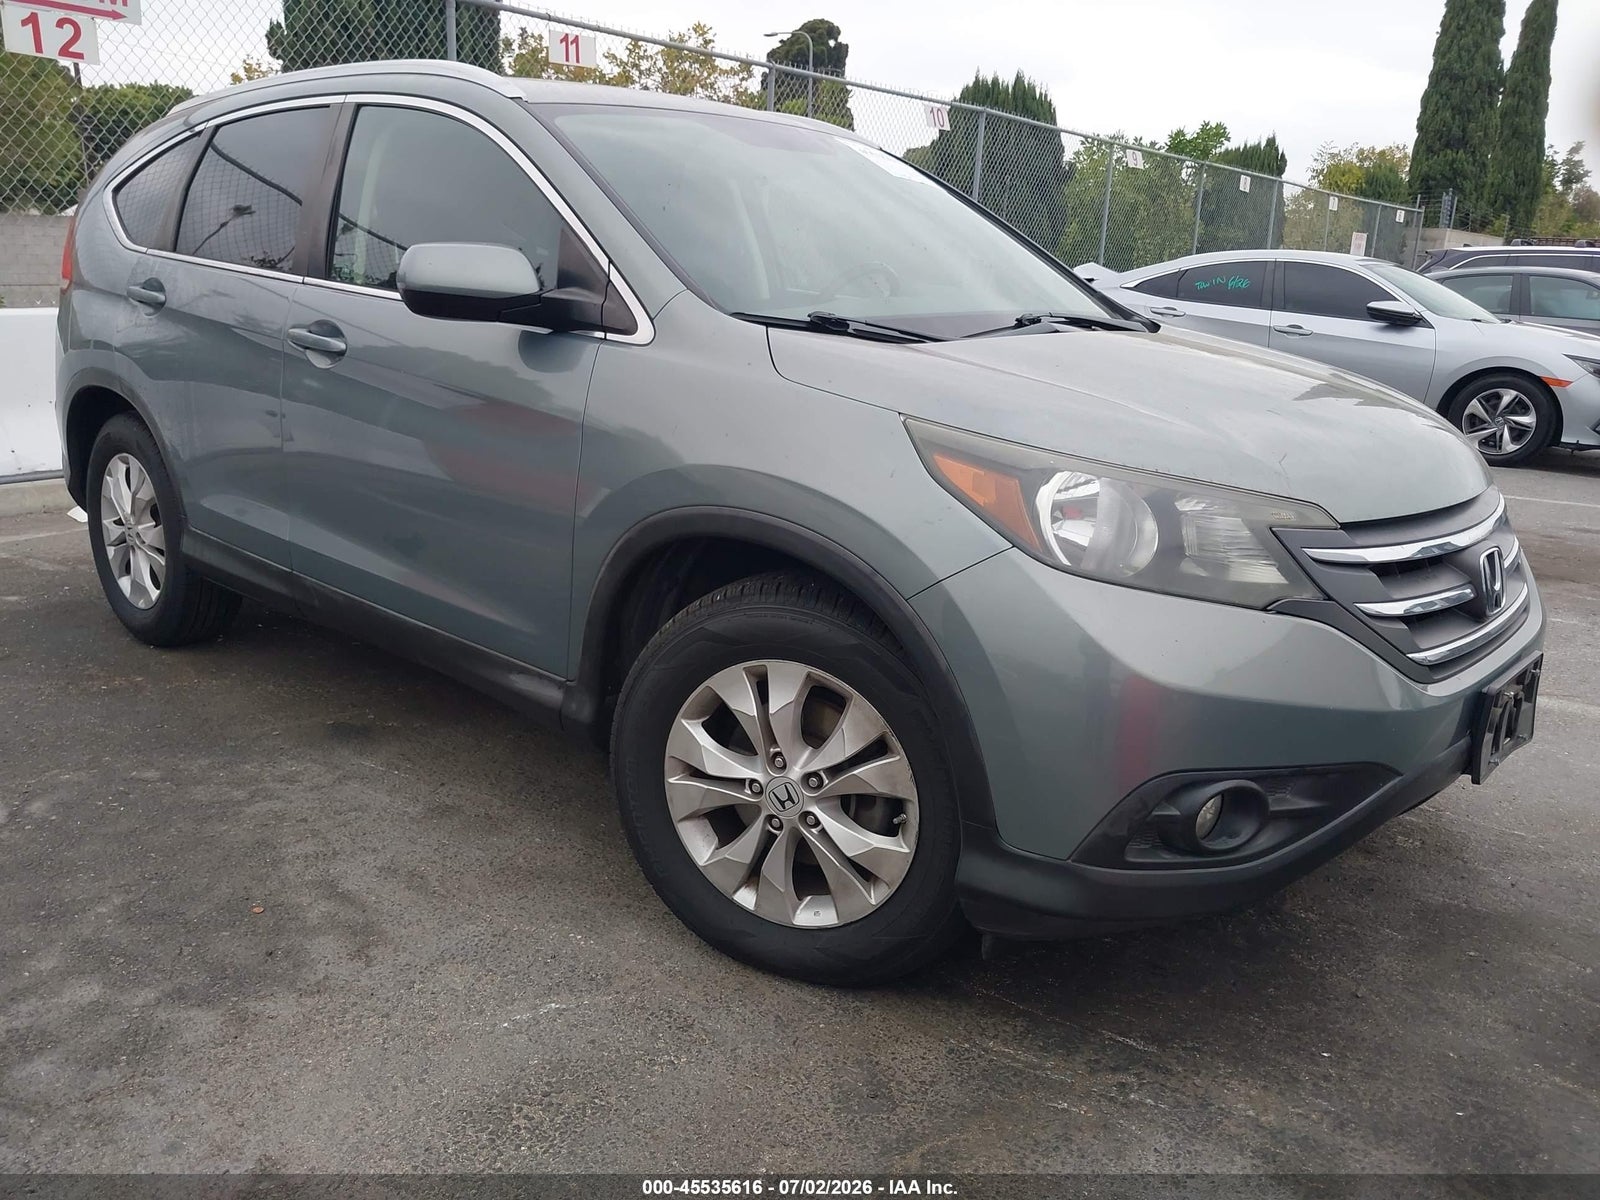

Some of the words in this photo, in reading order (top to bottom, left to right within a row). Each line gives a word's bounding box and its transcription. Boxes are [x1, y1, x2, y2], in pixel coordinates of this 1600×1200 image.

[20, 11, 85, 60] 12
[559, 32, 580, 64] 11
[929, 106, 945, 128] 10
[1131, 151, 1138, 166] 9
